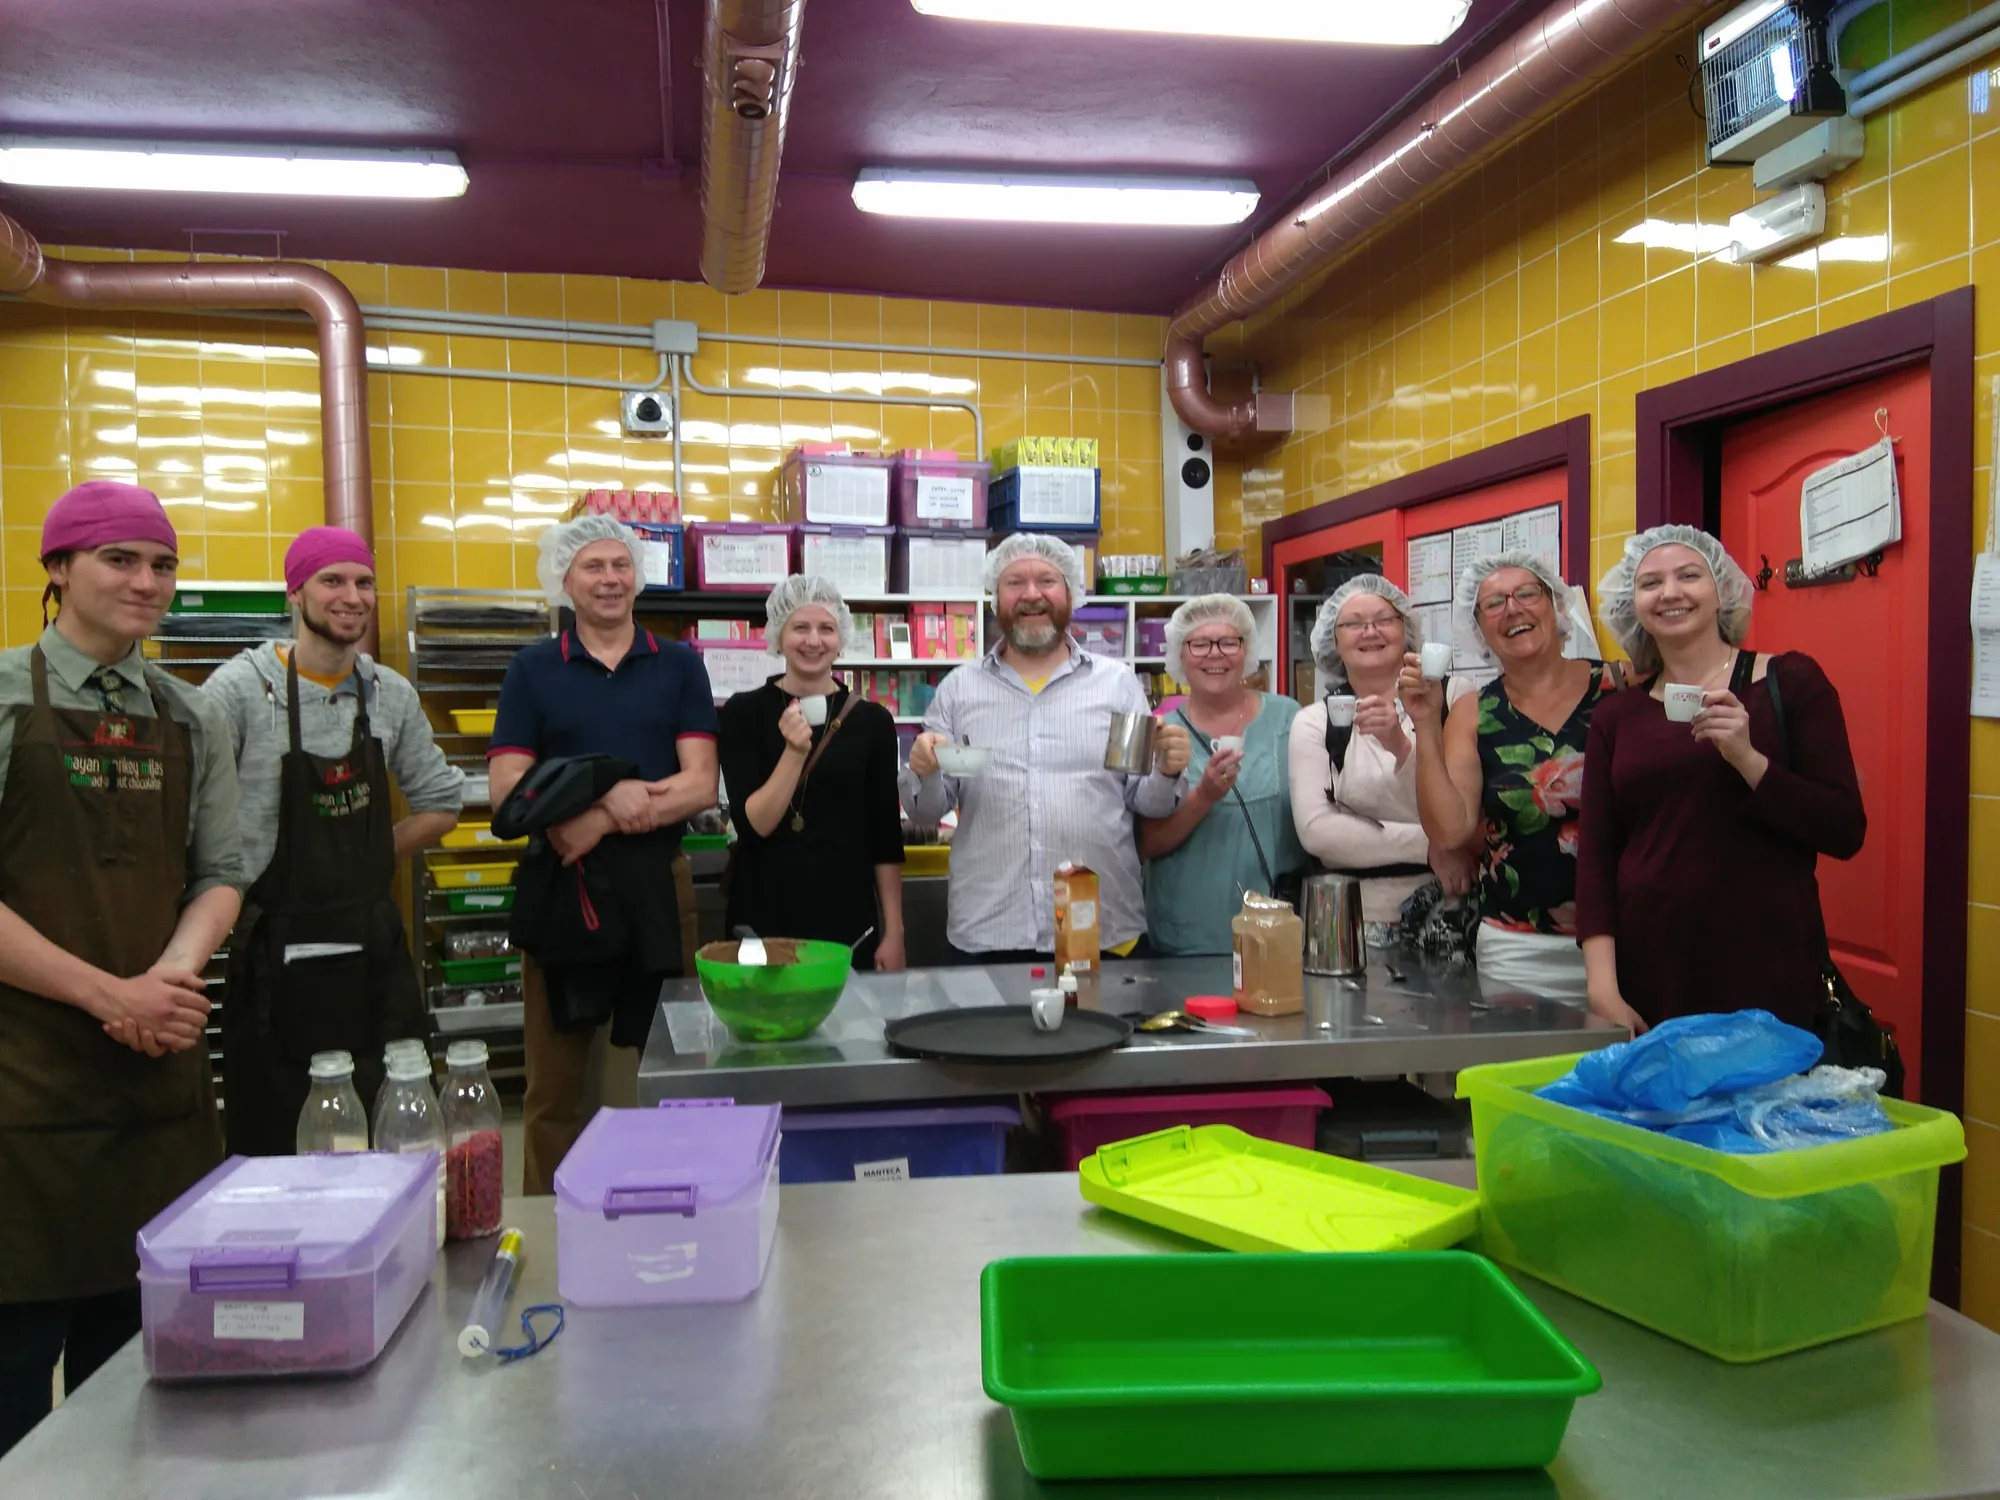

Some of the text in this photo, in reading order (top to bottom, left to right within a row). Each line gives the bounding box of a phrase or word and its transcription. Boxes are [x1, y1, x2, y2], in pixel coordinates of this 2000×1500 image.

[64, 754, 100, 775] mayan
[102, 756, 139, 779] mnkey
[103, 776, 128, 790] aut
[864, 1167, 900, 1177] MANTECA
